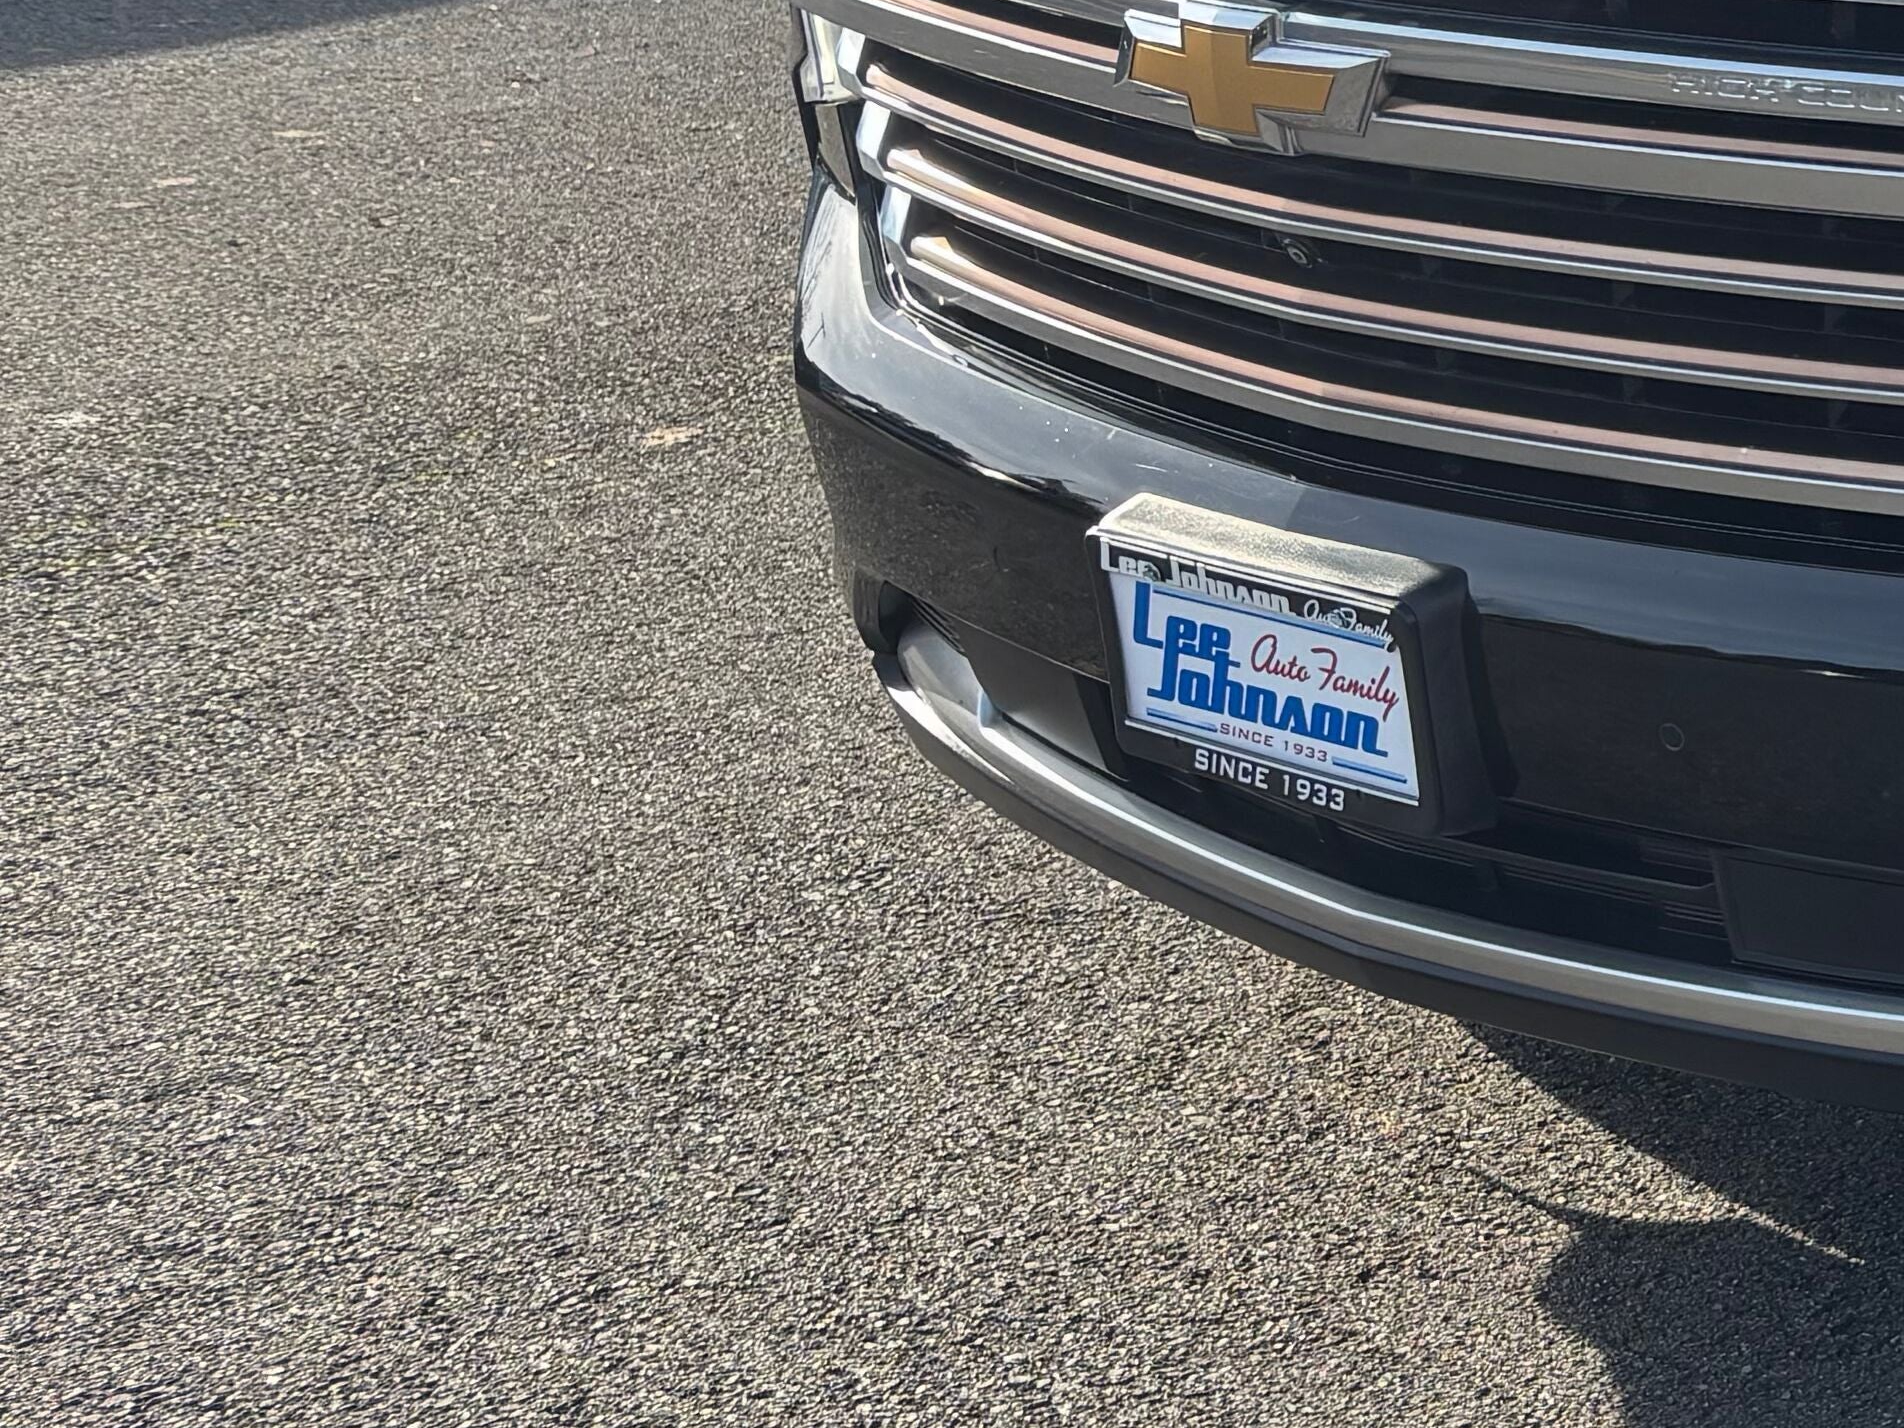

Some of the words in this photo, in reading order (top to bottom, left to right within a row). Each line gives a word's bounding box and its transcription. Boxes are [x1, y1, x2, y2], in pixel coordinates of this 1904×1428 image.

[1133, 581, 1241, 669] Lee
[1251, 634, 1311, 682] Auto
[1311, 647, 1400, 722] Family
[1165, 556, 1300, 616] Johnson
[1339, 607, 1395, 652] Family
[1147, 647, 1389, 758] Johnson
[1220, 722, 1275, 748] SINCE
[1284, 739, 1328, 762] 1933
[1195, 748, 1270, 790] SINCE
[1282, 774, 1346, 811] 1933
